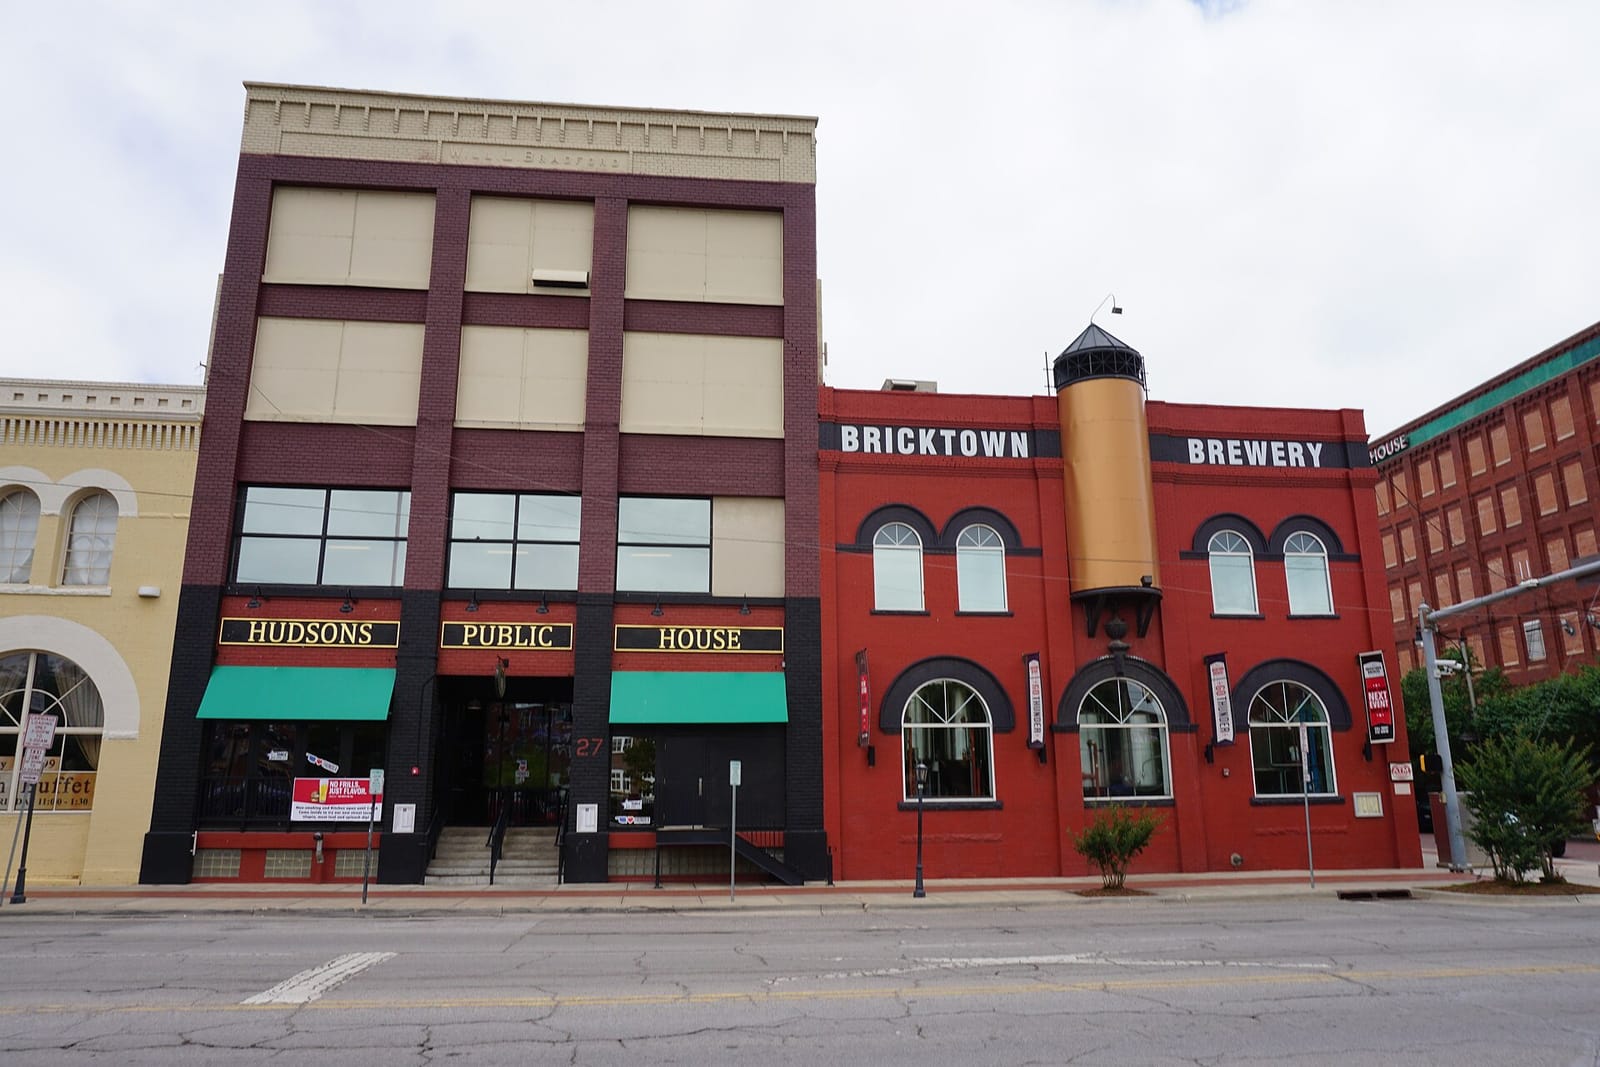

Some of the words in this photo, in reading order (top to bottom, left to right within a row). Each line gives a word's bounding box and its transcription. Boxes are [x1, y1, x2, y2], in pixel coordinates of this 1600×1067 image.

[841, 424, 1029, 458] BRICKTOWN
[1369, 434, 1408, 465] HOUSE
[1187, 438, 1323, 468] BREWERY
[247, 621, 373, 645] HUDSONS
[462, 624, 553, 647] PUBLIC
[659, 628, 741, 650] HOUSE
[1368, 691, 1387, 701] NEXT
[1369, 700, 1389, 709] EVENT
[576, 737, 604, 757] 27
[343, 787, 367, 795] FLAVOR.
